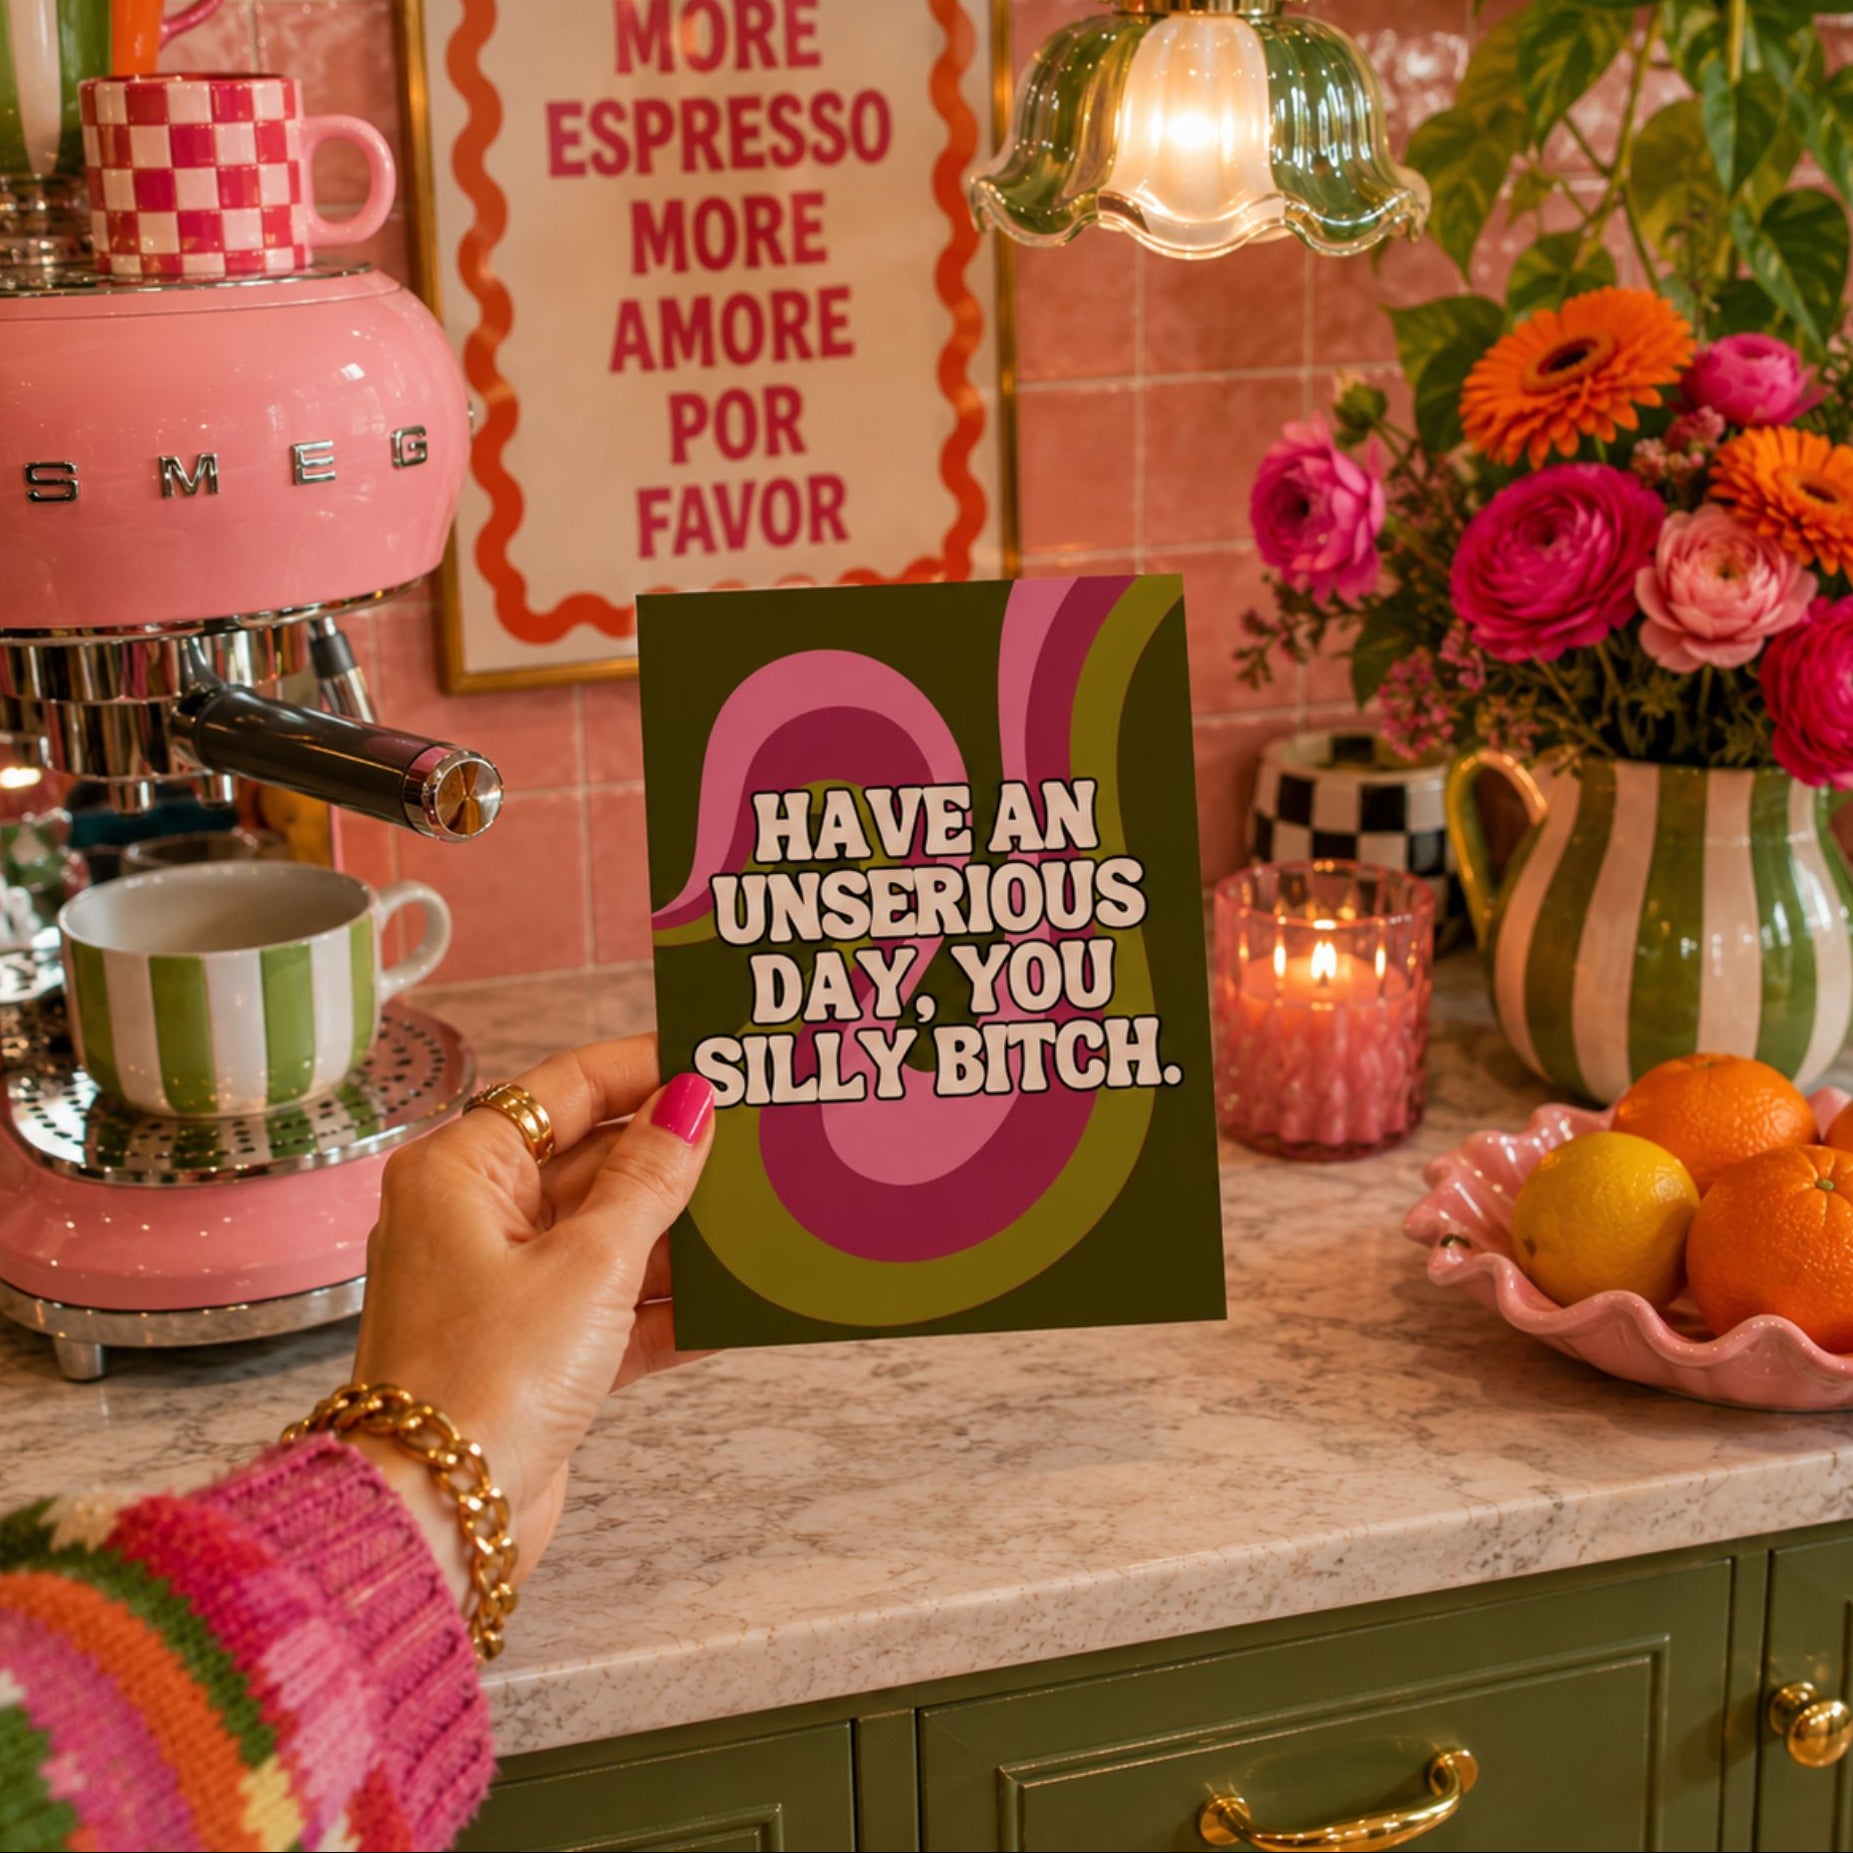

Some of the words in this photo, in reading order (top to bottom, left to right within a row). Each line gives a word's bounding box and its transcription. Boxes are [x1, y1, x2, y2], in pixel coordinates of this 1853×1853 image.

[613, 0, 823, 76] MORE
[546, 88, 893, 178] ESPRESSO
[631, 190, 829, 277] MORE
[608, 285, 855, 374] AMORE
[23, 425, 428, 502] SMEG
[668, 384, 807, 465] POR
[636, 473, 850, 560] FAVOR
[752, 783, 974, 864] HAVE
[986, 777, 1100, 853] AN
[710, 856, 1148, 946] UNSERIOUS
[748, 945, 938, 1025] DAY,
[950, 937, 1116, 1016] YOU
[693, 1027, 918, 1108] SILLY
[933, 1014, 1184, 1097] BITCH.
